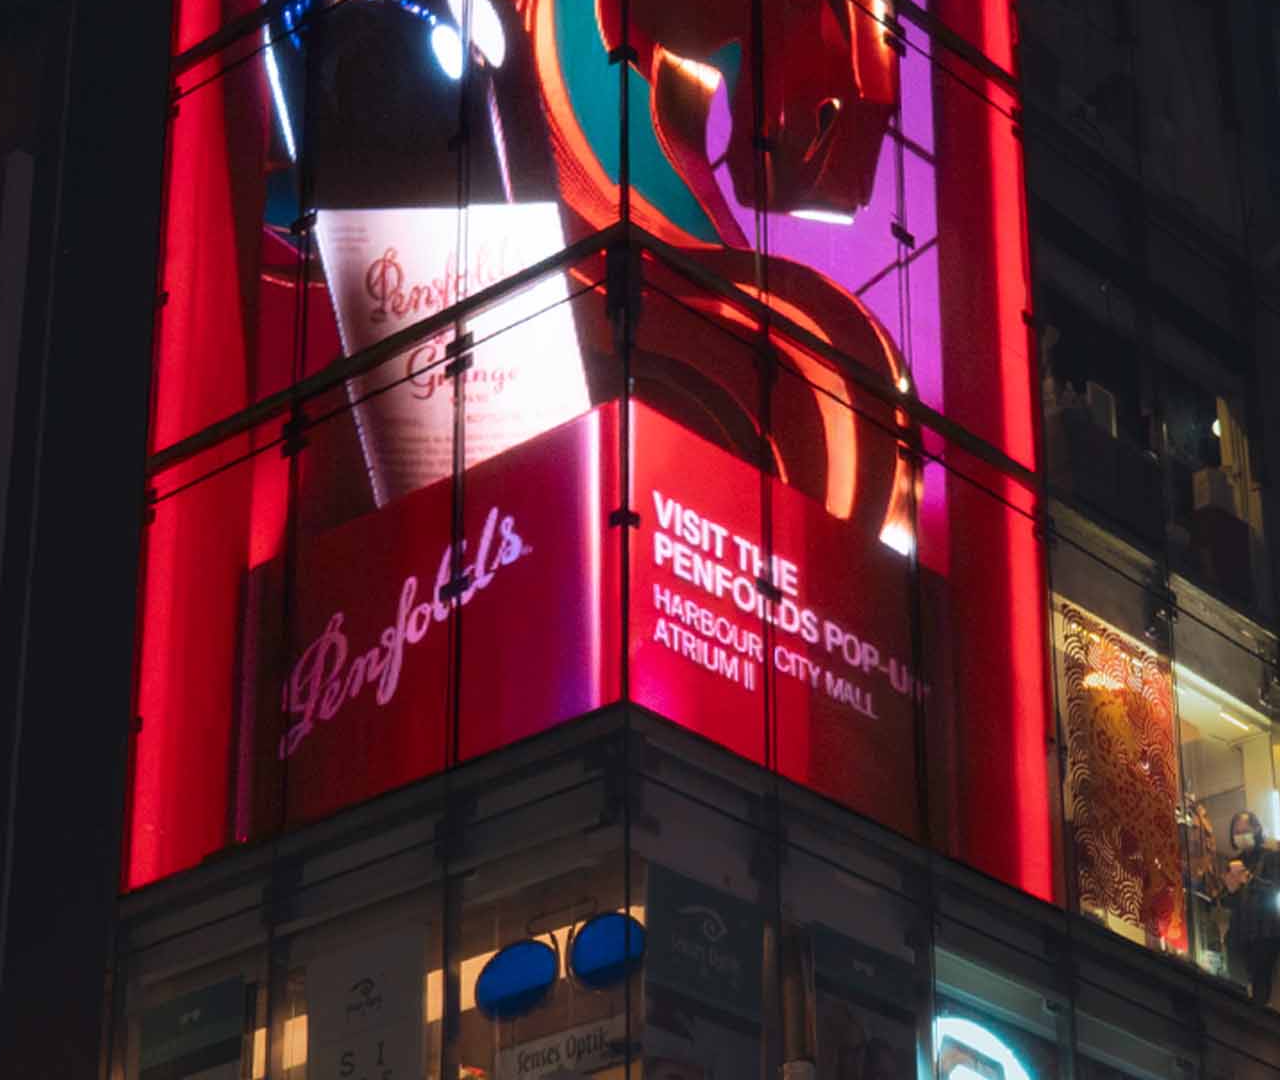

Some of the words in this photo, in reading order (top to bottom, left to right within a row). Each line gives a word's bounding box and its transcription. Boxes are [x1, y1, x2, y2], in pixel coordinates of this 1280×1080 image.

[652, 489, 728, 559] VISIT
[733, 535, 798, 597] THE
[652, 583, 764, 663] HARBOUR
[774, 645, 822, 689] CITY
[825, 670, 879, 720] MALL
[653, 531, 819, 644] PENFOLDS
[823, 620, 929, 697] POP-U
[653, 618, 740, 683] ATRIUM
